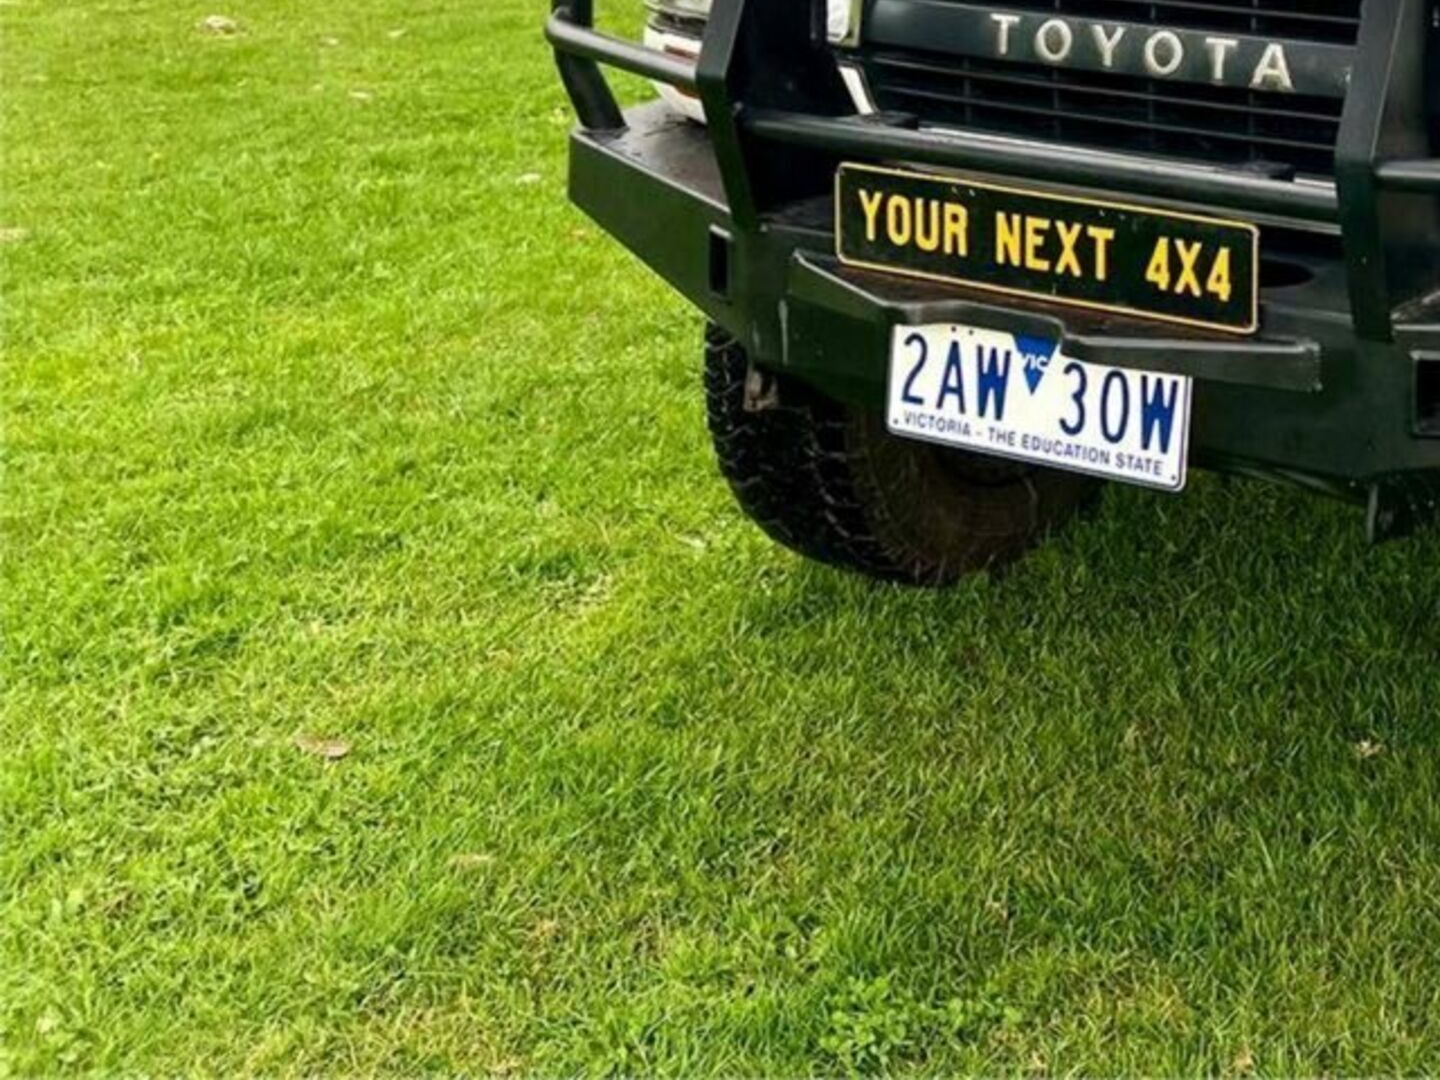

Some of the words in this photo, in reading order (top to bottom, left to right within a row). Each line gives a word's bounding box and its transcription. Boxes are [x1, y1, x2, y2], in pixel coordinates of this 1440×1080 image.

[989, 13, 1296, 93] TOYOTA
[857, 189, 969, 258] YOUR
[995, 211, 1115, 282] NEXT
[1145, 236, 1233, 303] 4X4
[900, 332, 1013, 422] 2AW
[903, 410, 972, 438] VICTORIA
[988, 426, 1017, 448] THE
[1020, 435, 1111, 465] EDUCATION
[1115, 453, 1165, 476] STATE
